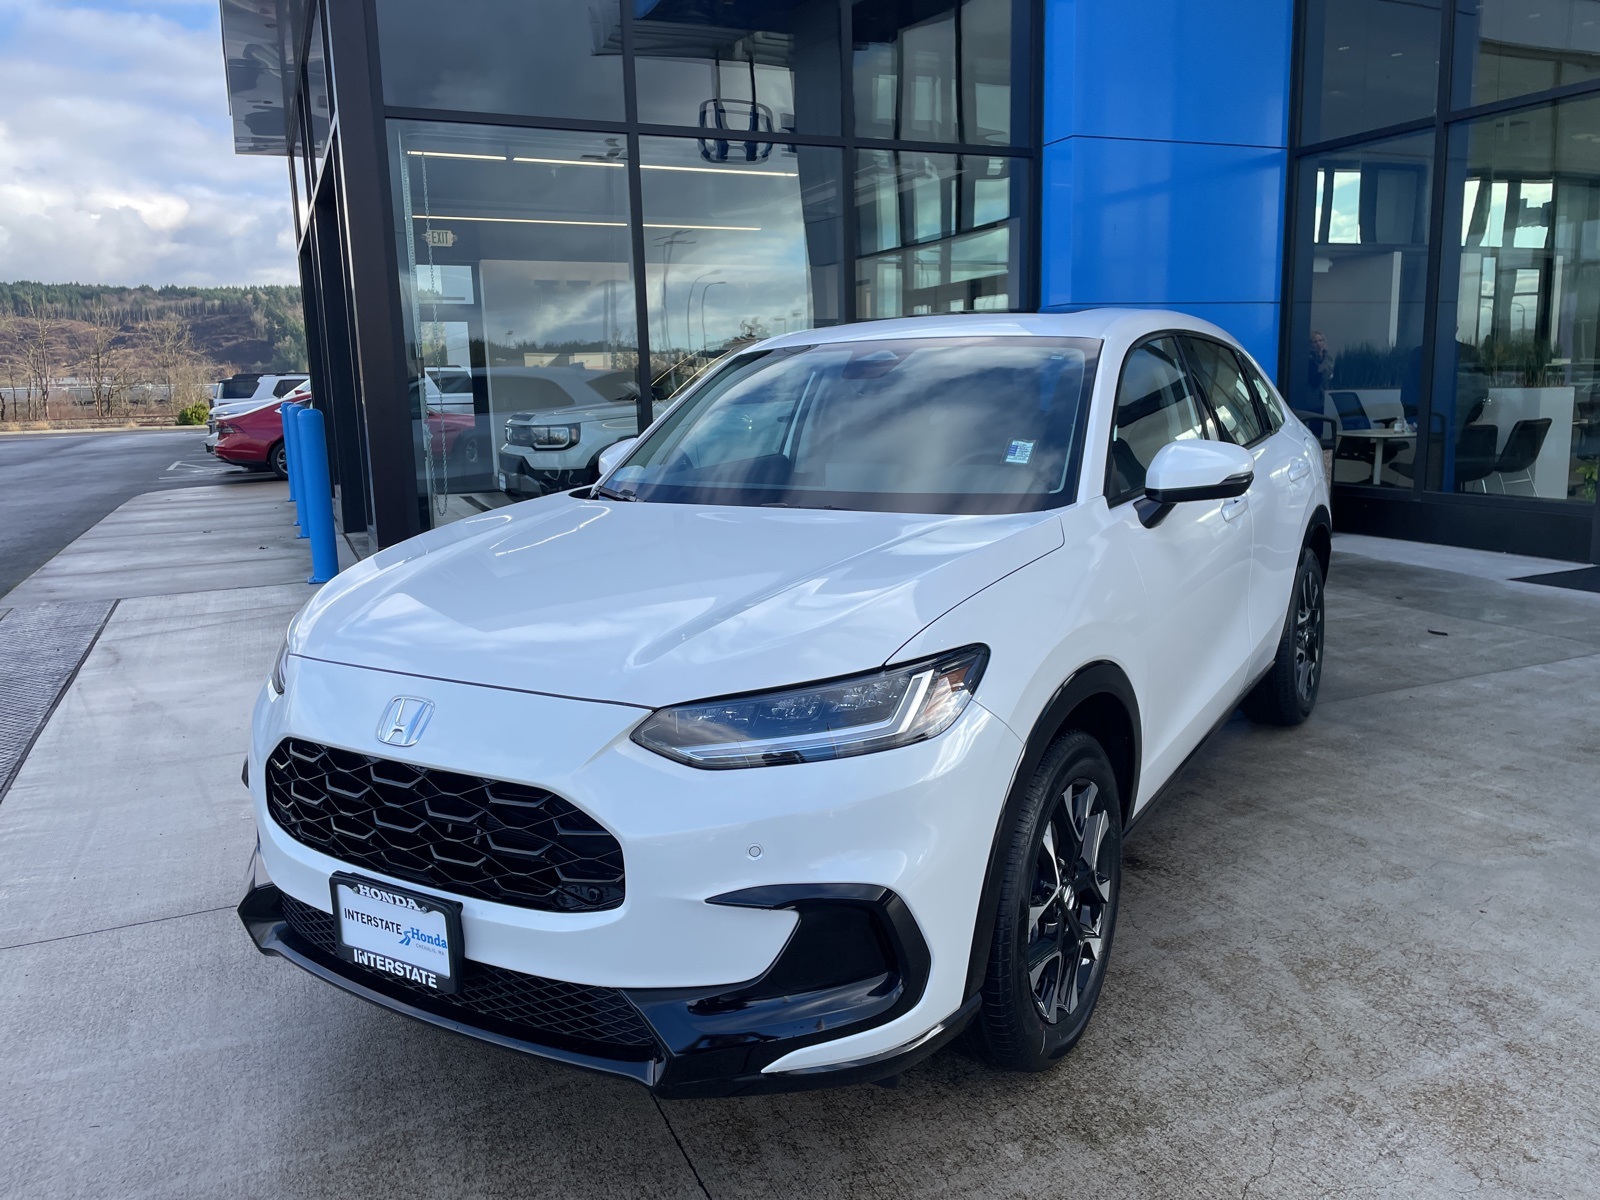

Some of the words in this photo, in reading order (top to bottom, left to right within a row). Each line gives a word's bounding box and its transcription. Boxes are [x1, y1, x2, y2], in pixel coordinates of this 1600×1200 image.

[431, 231, 448, 244] EXIT
[357, 884, 420, 911] HONDA
[344, 908, 402, 935] INTERSTATE
[411, 927, 447, 949] Honda
[353, 948, 437, 989] INTERSTATE
